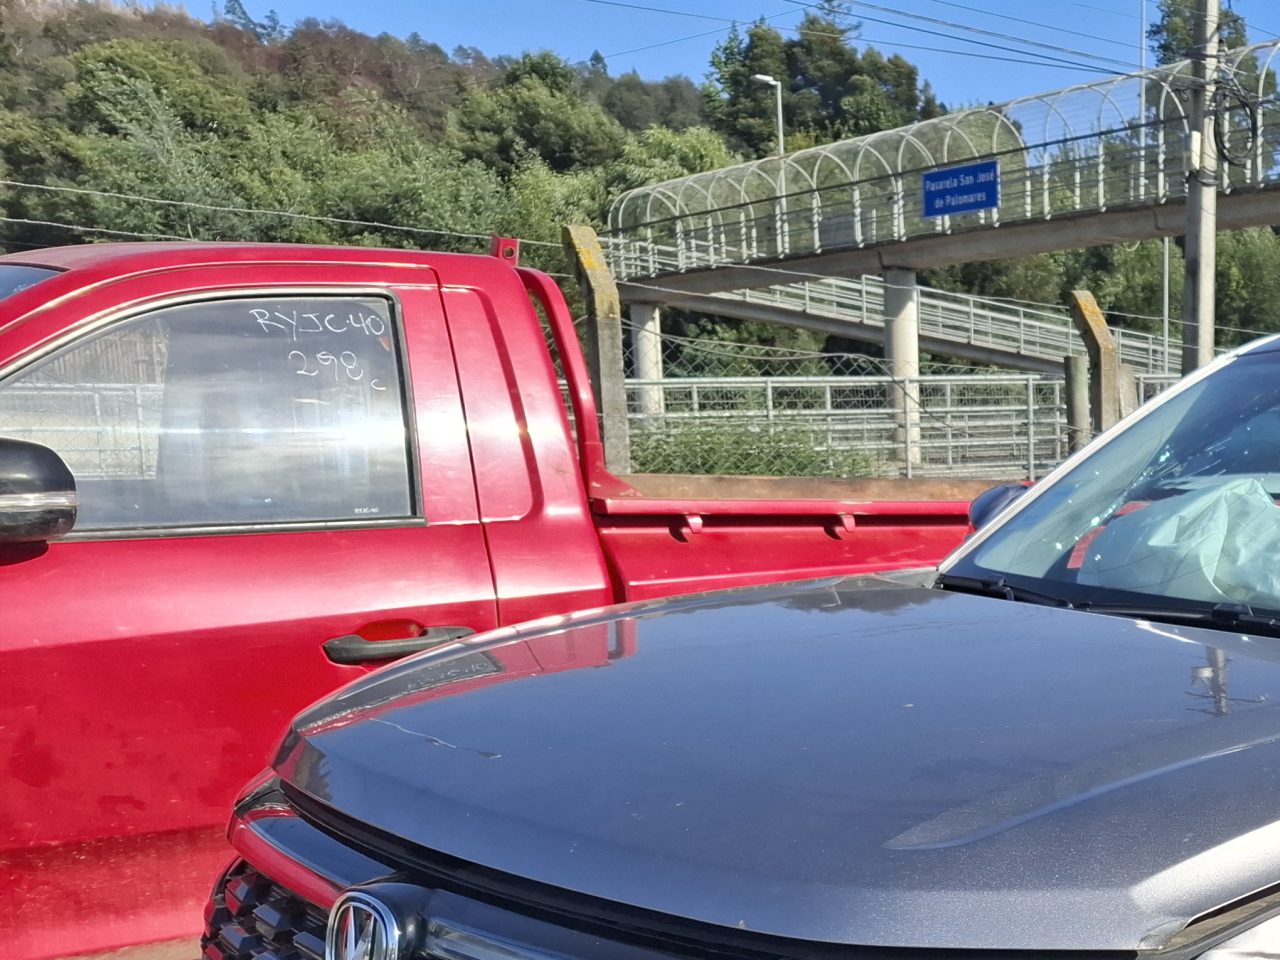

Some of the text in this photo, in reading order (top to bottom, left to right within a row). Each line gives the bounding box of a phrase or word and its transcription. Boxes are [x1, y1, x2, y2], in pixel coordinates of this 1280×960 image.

[926, 177, 958, 191] Pasarela
[960, 174, 974, 186] San
[935, 192, 986, 209] de Palomares
